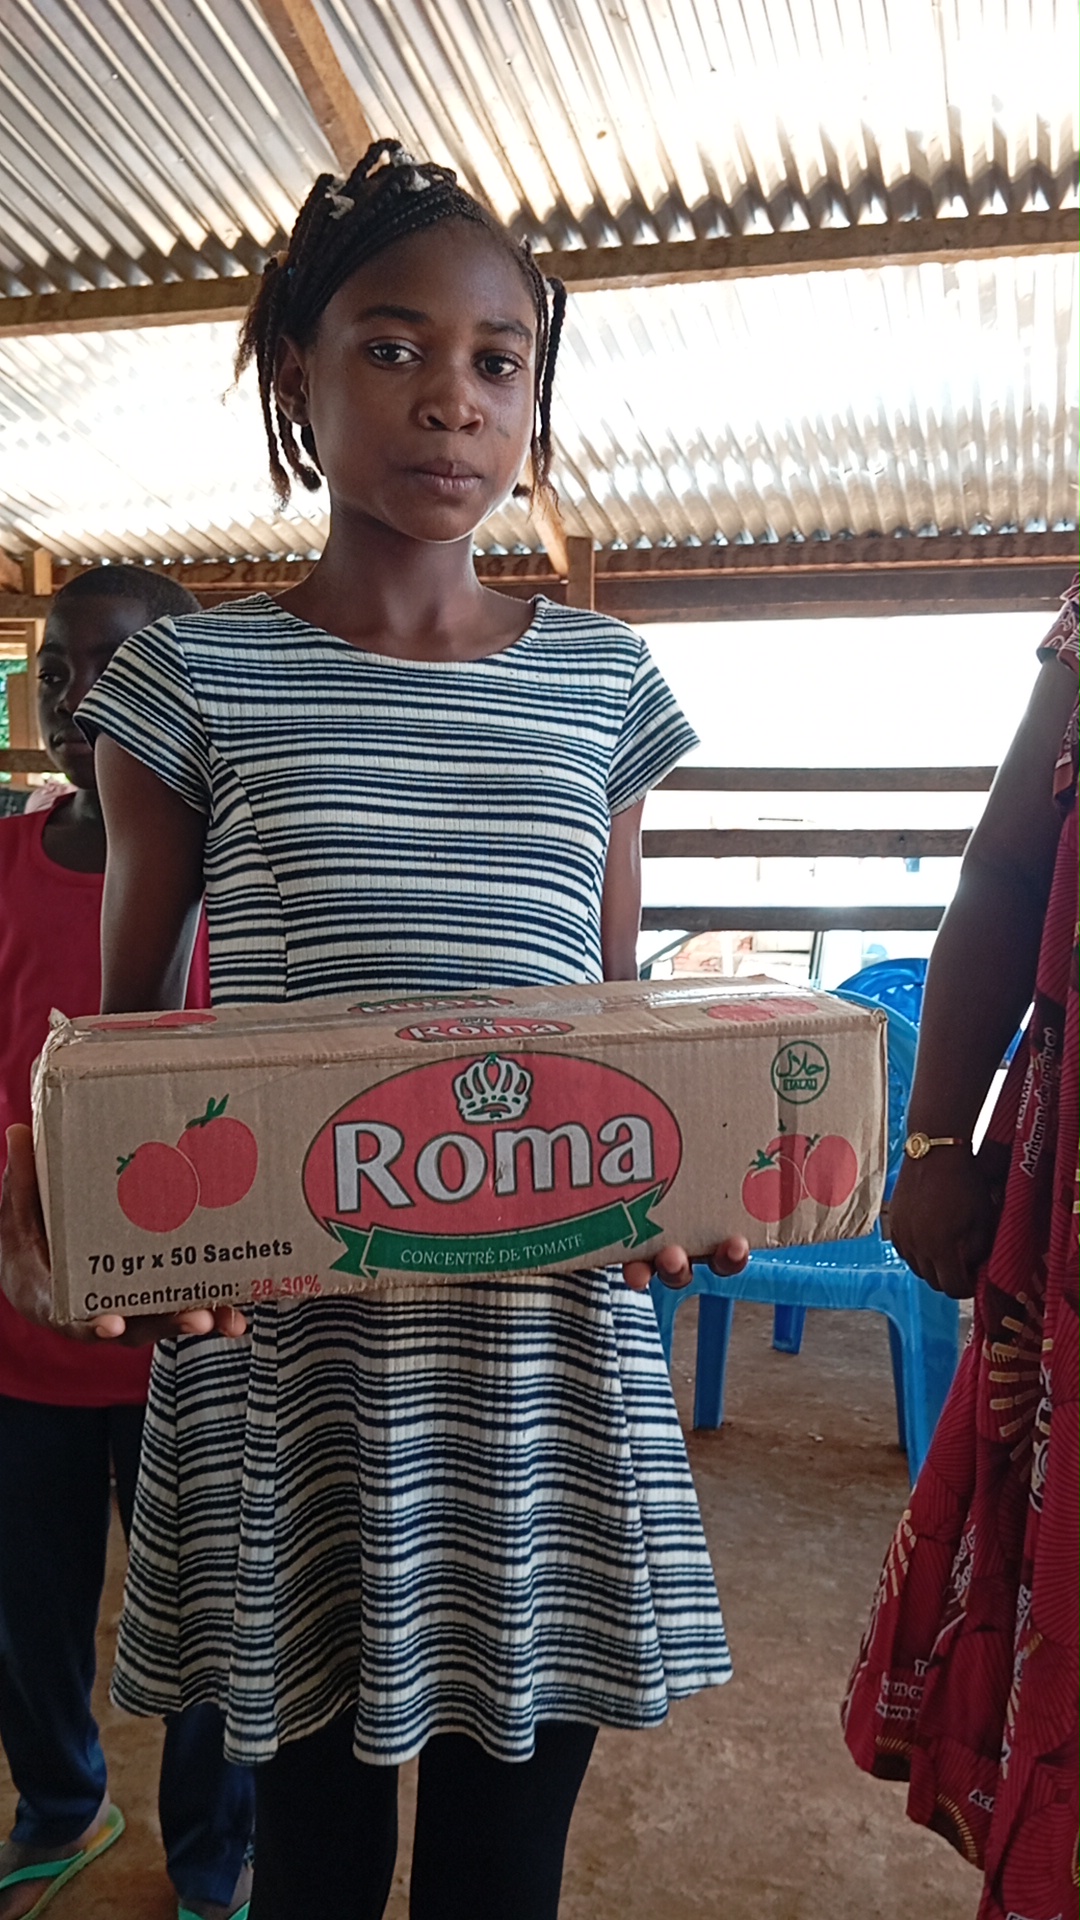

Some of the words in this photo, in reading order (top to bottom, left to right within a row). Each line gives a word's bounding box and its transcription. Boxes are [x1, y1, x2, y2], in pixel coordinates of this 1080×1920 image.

[409, 1022, 561, 1039] Roma
[334, 1114, 655, 1213] Roma
[88, 1255, 115, 1275] 70
[122, 1255, 145, 1276] gr
[151, 1254, 164, 1268] x
[171, 1246, 197, 1266] 50
[204, 1239, 293, 1263] Sachets
[400, 1248, 495, 1266] CONCENTRÉ
[500, 1249, 520, 1263] DE
[523, 1234, 584, 1259] TOMATE
[85, 1281, 240, 1311] Concentration:
